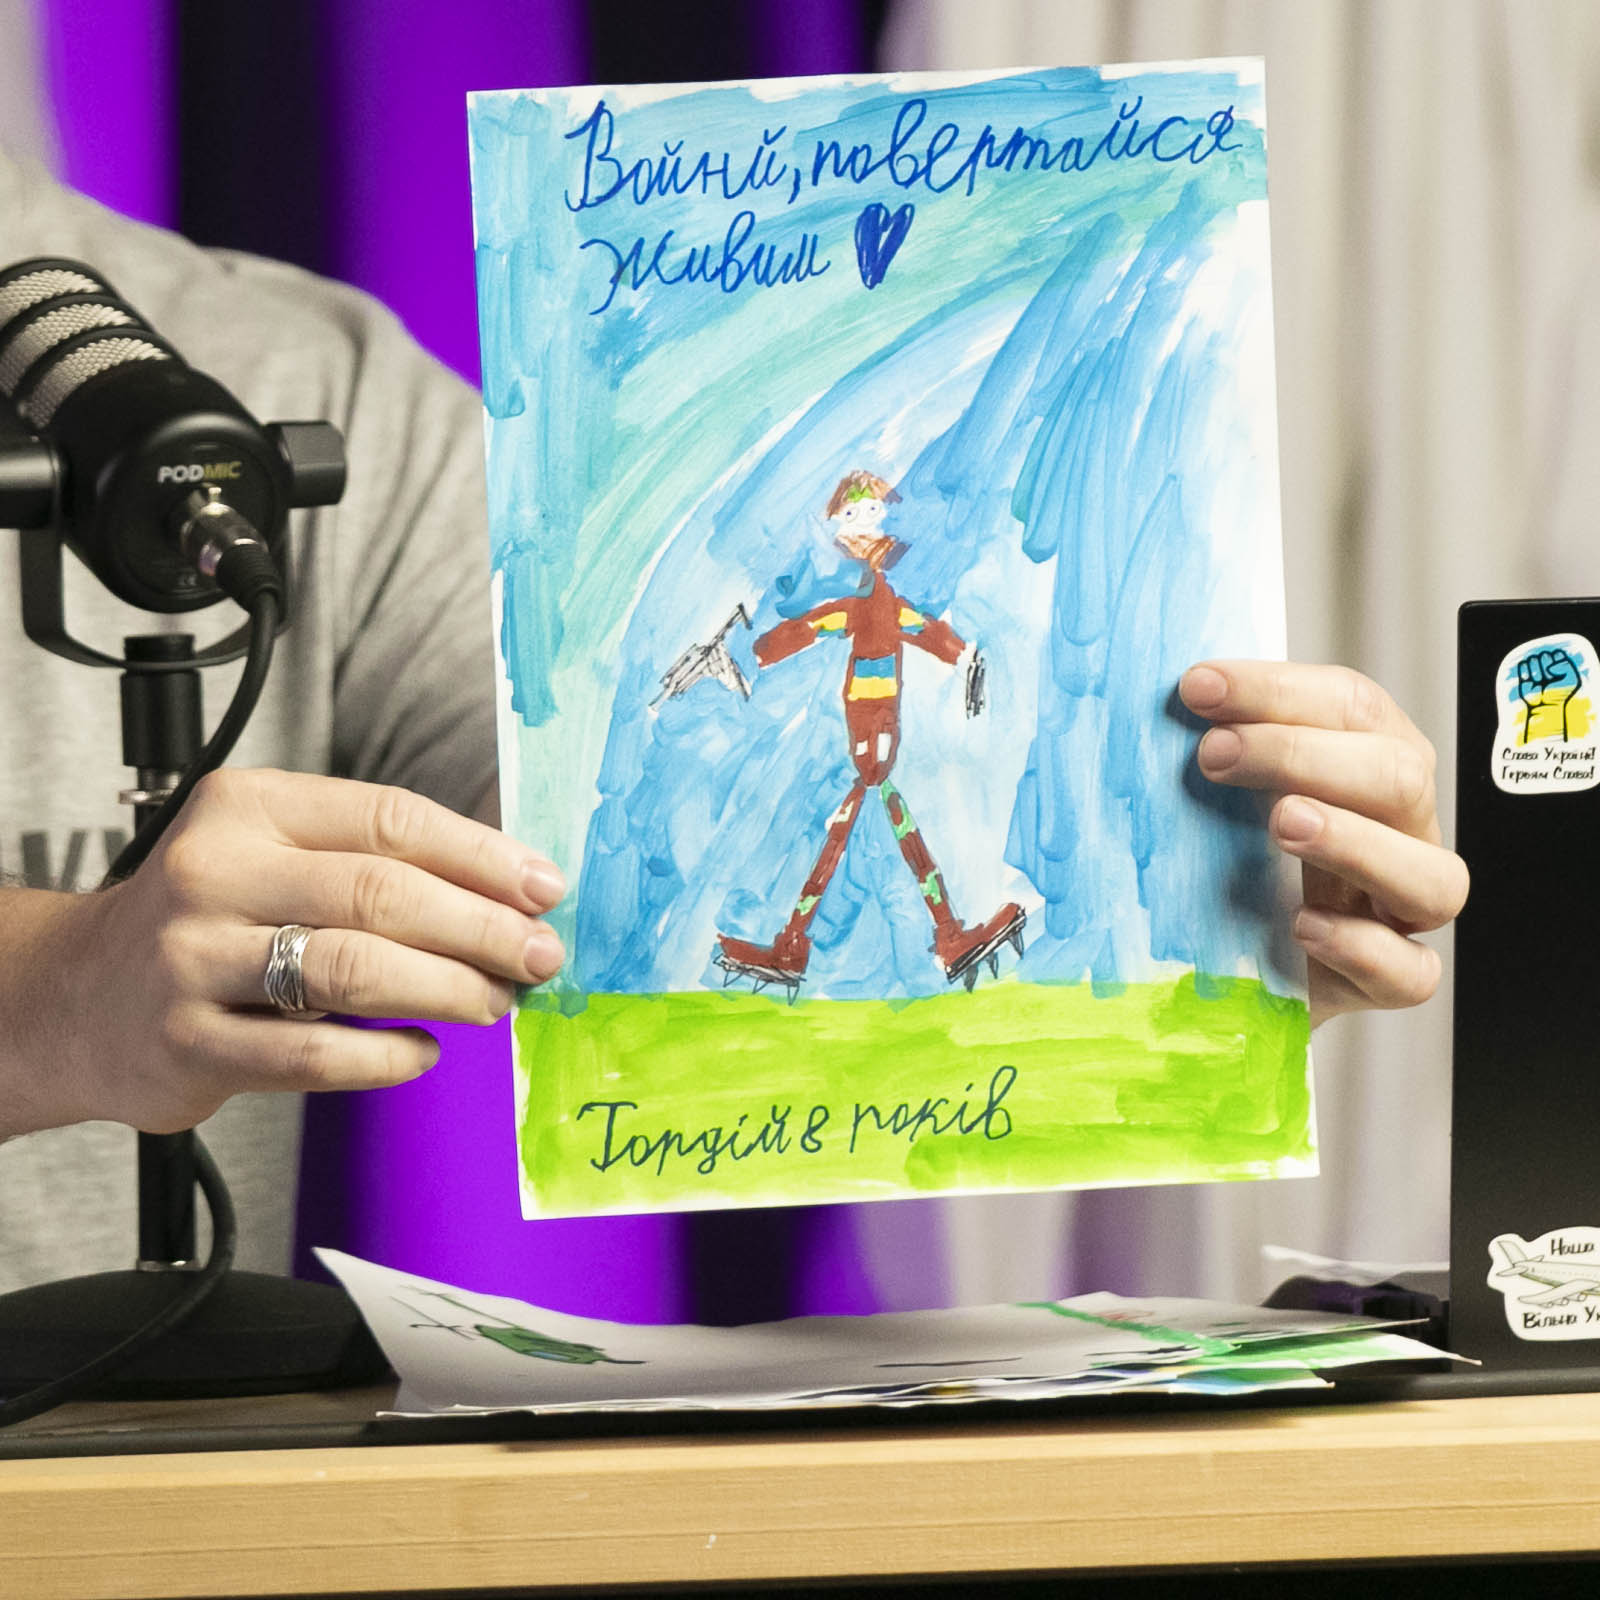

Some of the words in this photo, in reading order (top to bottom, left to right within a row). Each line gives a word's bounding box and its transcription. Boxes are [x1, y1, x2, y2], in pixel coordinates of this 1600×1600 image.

[811, 95, 1243, 197] повертайся
[157, 460, 242, 483] PODMIC
[849, 1065, 1017, 1153] років
